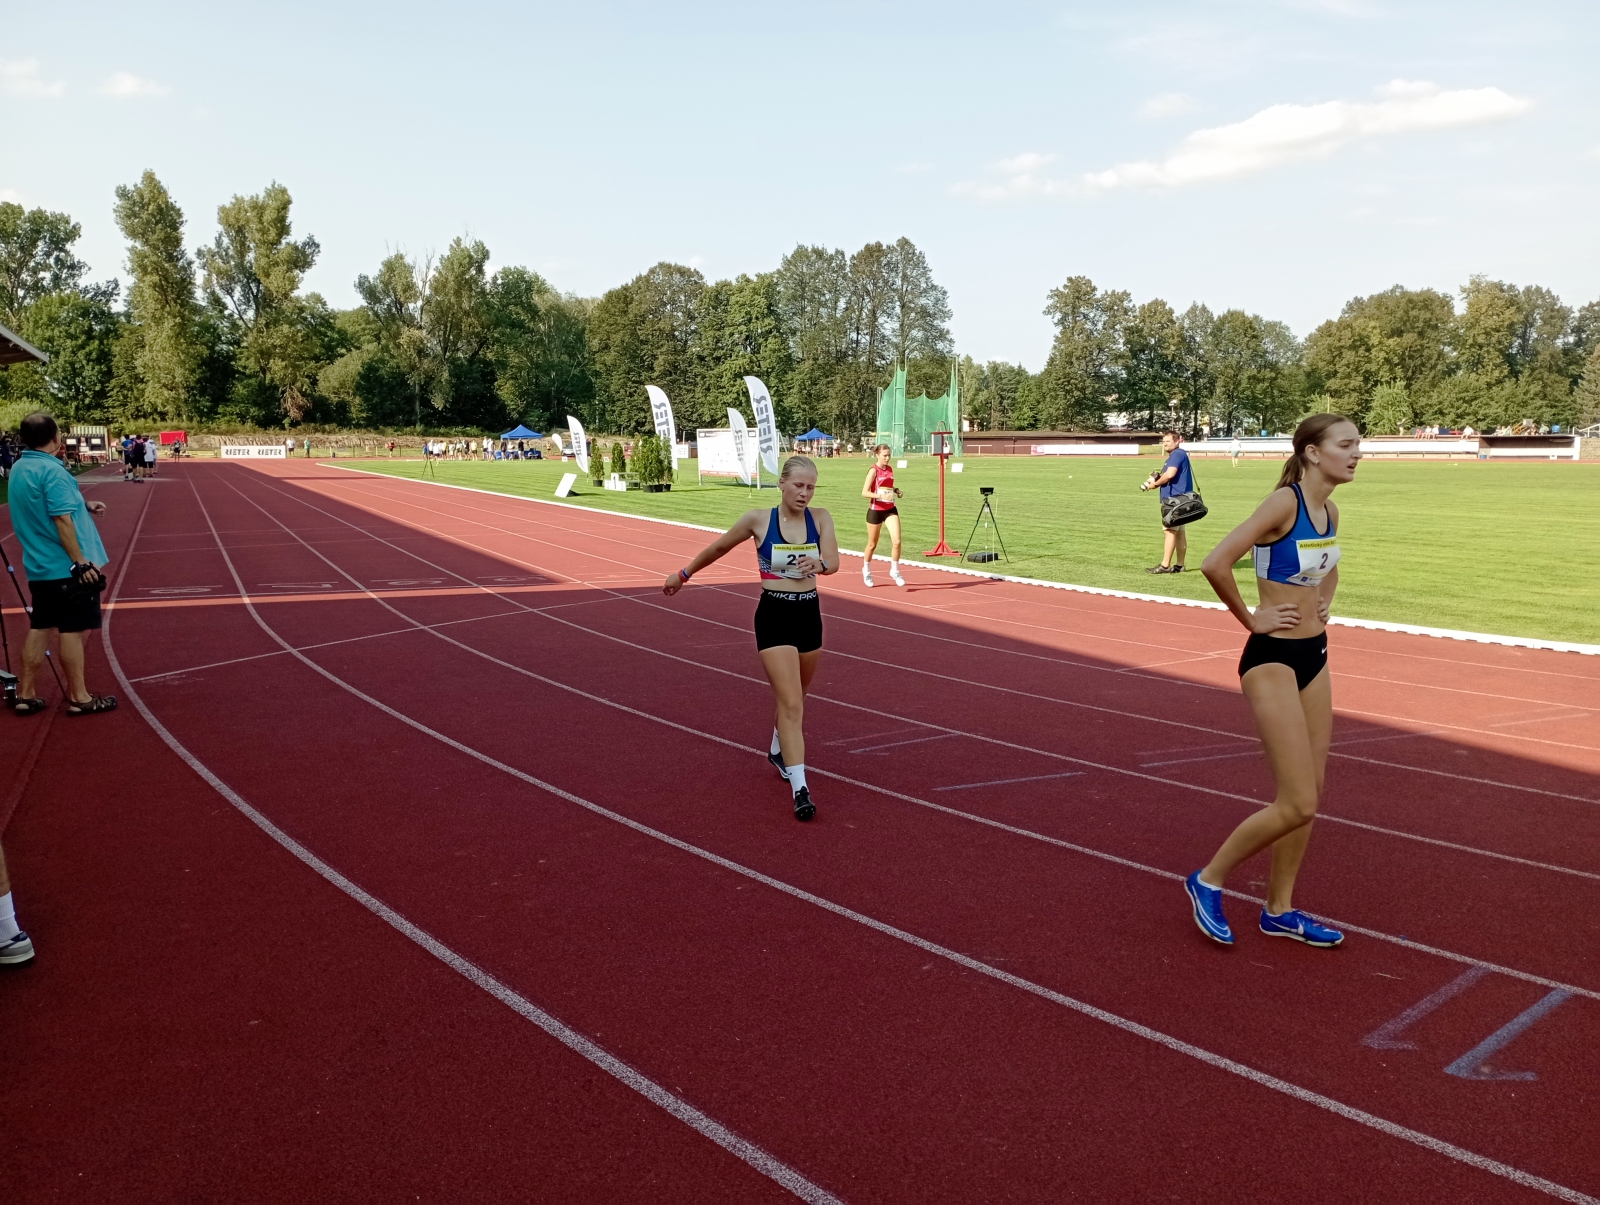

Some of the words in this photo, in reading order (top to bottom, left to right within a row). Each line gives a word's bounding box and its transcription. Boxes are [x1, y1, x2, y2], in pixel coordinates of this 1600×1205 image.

[225, 448, 250, 456] RIETER
[257, 448, 282, 456] RIETER
[1319, 552, 1329, 570] 2
[768, 591, 797, 600] NIKE
[799, 590, 817, 601] PRO
